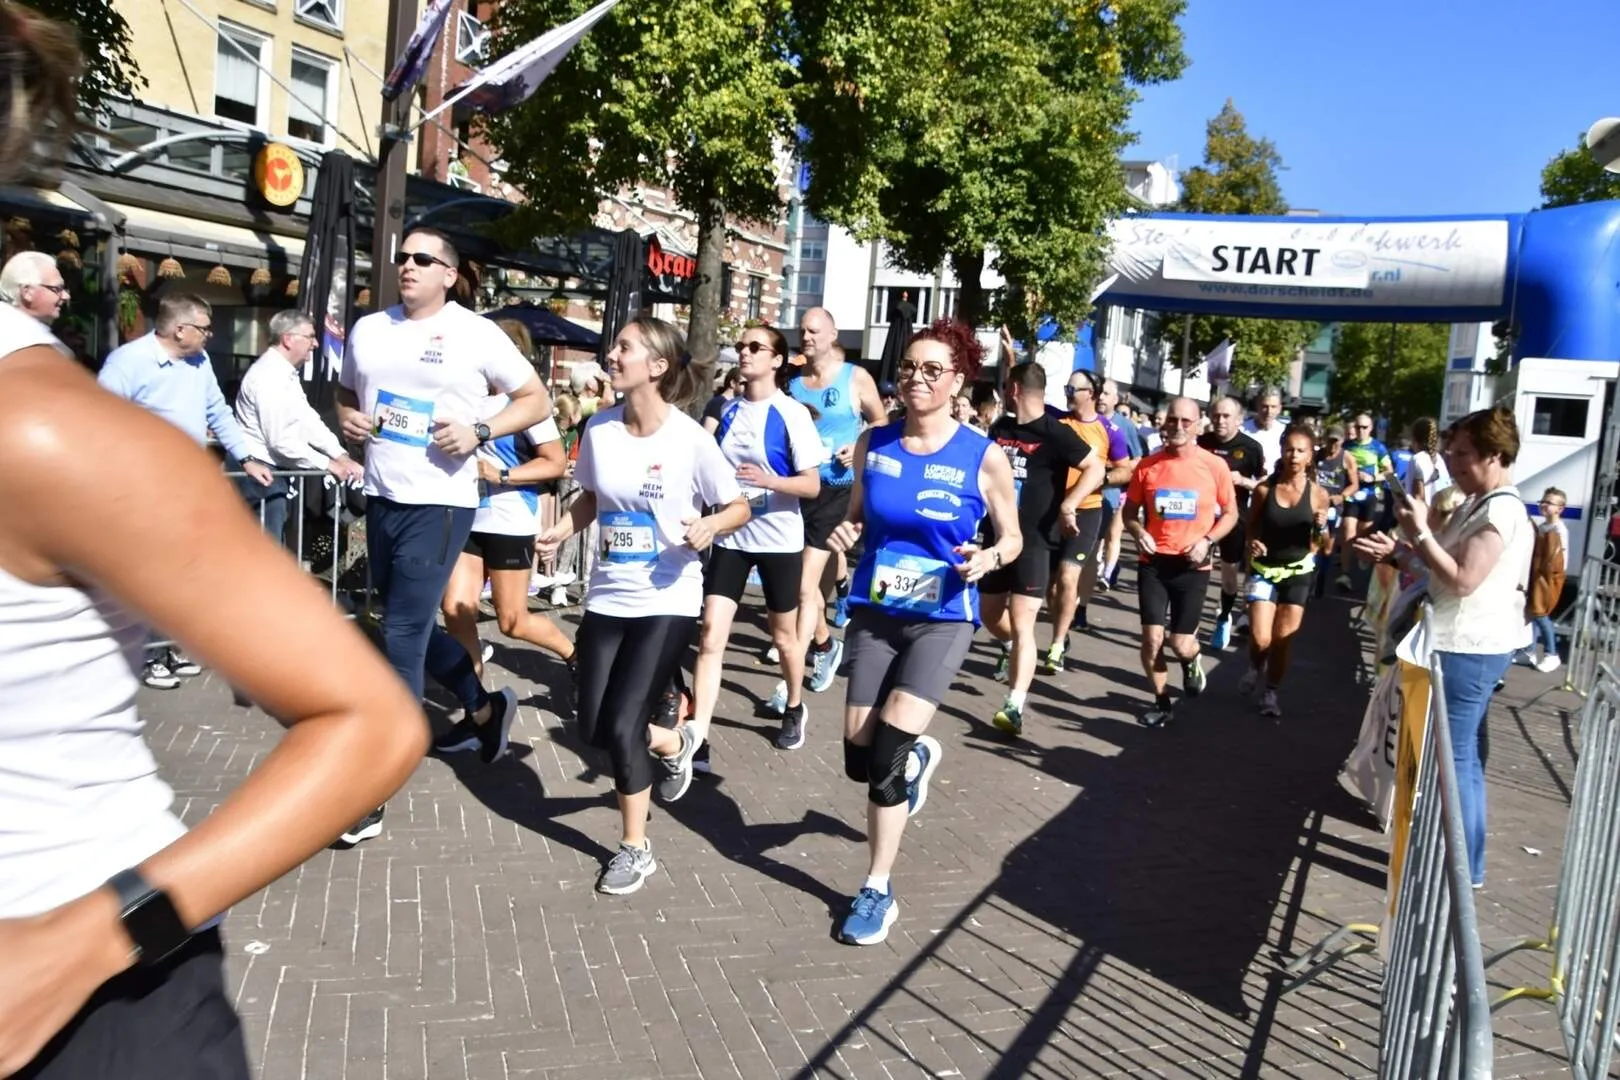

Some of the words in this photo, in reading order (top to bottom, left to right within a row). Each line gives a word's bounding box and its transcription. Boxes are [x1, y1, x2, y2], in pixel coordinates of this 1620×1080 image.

[1211, 245, 1321, 277] START
[388, 412, 408, 430] 296
[643, 482, 662, 491] HEEM
[613, 531, 633, 547] 295
[894, 575, 919, 593] 337
